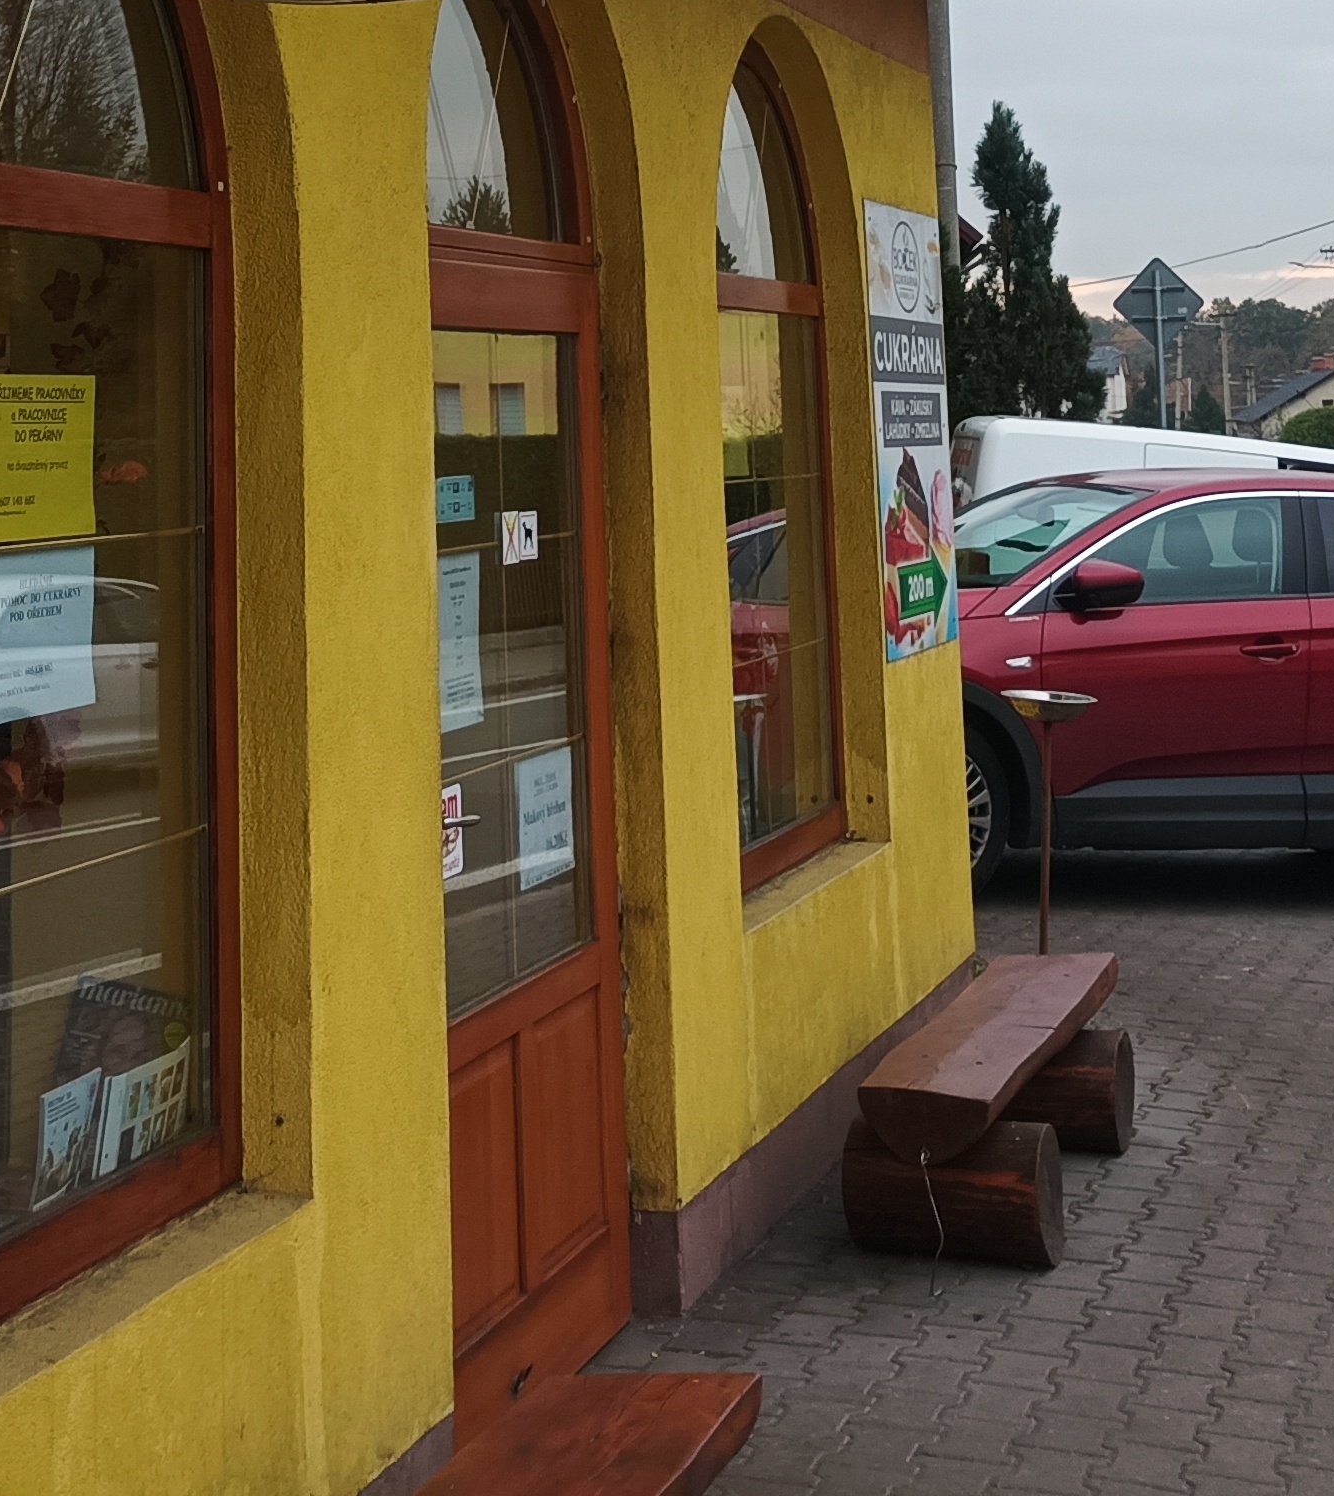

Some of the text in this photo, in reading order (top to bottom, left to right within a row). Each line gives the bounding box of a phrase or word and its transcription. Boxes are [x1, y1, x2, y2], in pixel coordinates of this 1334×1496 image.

[874, 324, 944, 375] CUKRÁRNA
[35, 384, 87, 401] PRACOVNÍKY
[890, 394, 907, 416] KÁVA
[18, 407, 68, 422] PRACOVNICE
[14, 426, 64, 443] DO PEKÁRNY
[908, 573, 935, 602] 200 m
[30, 592, 42, 605] DO
[9, 604, 63, 623] POD OŘECHEM
